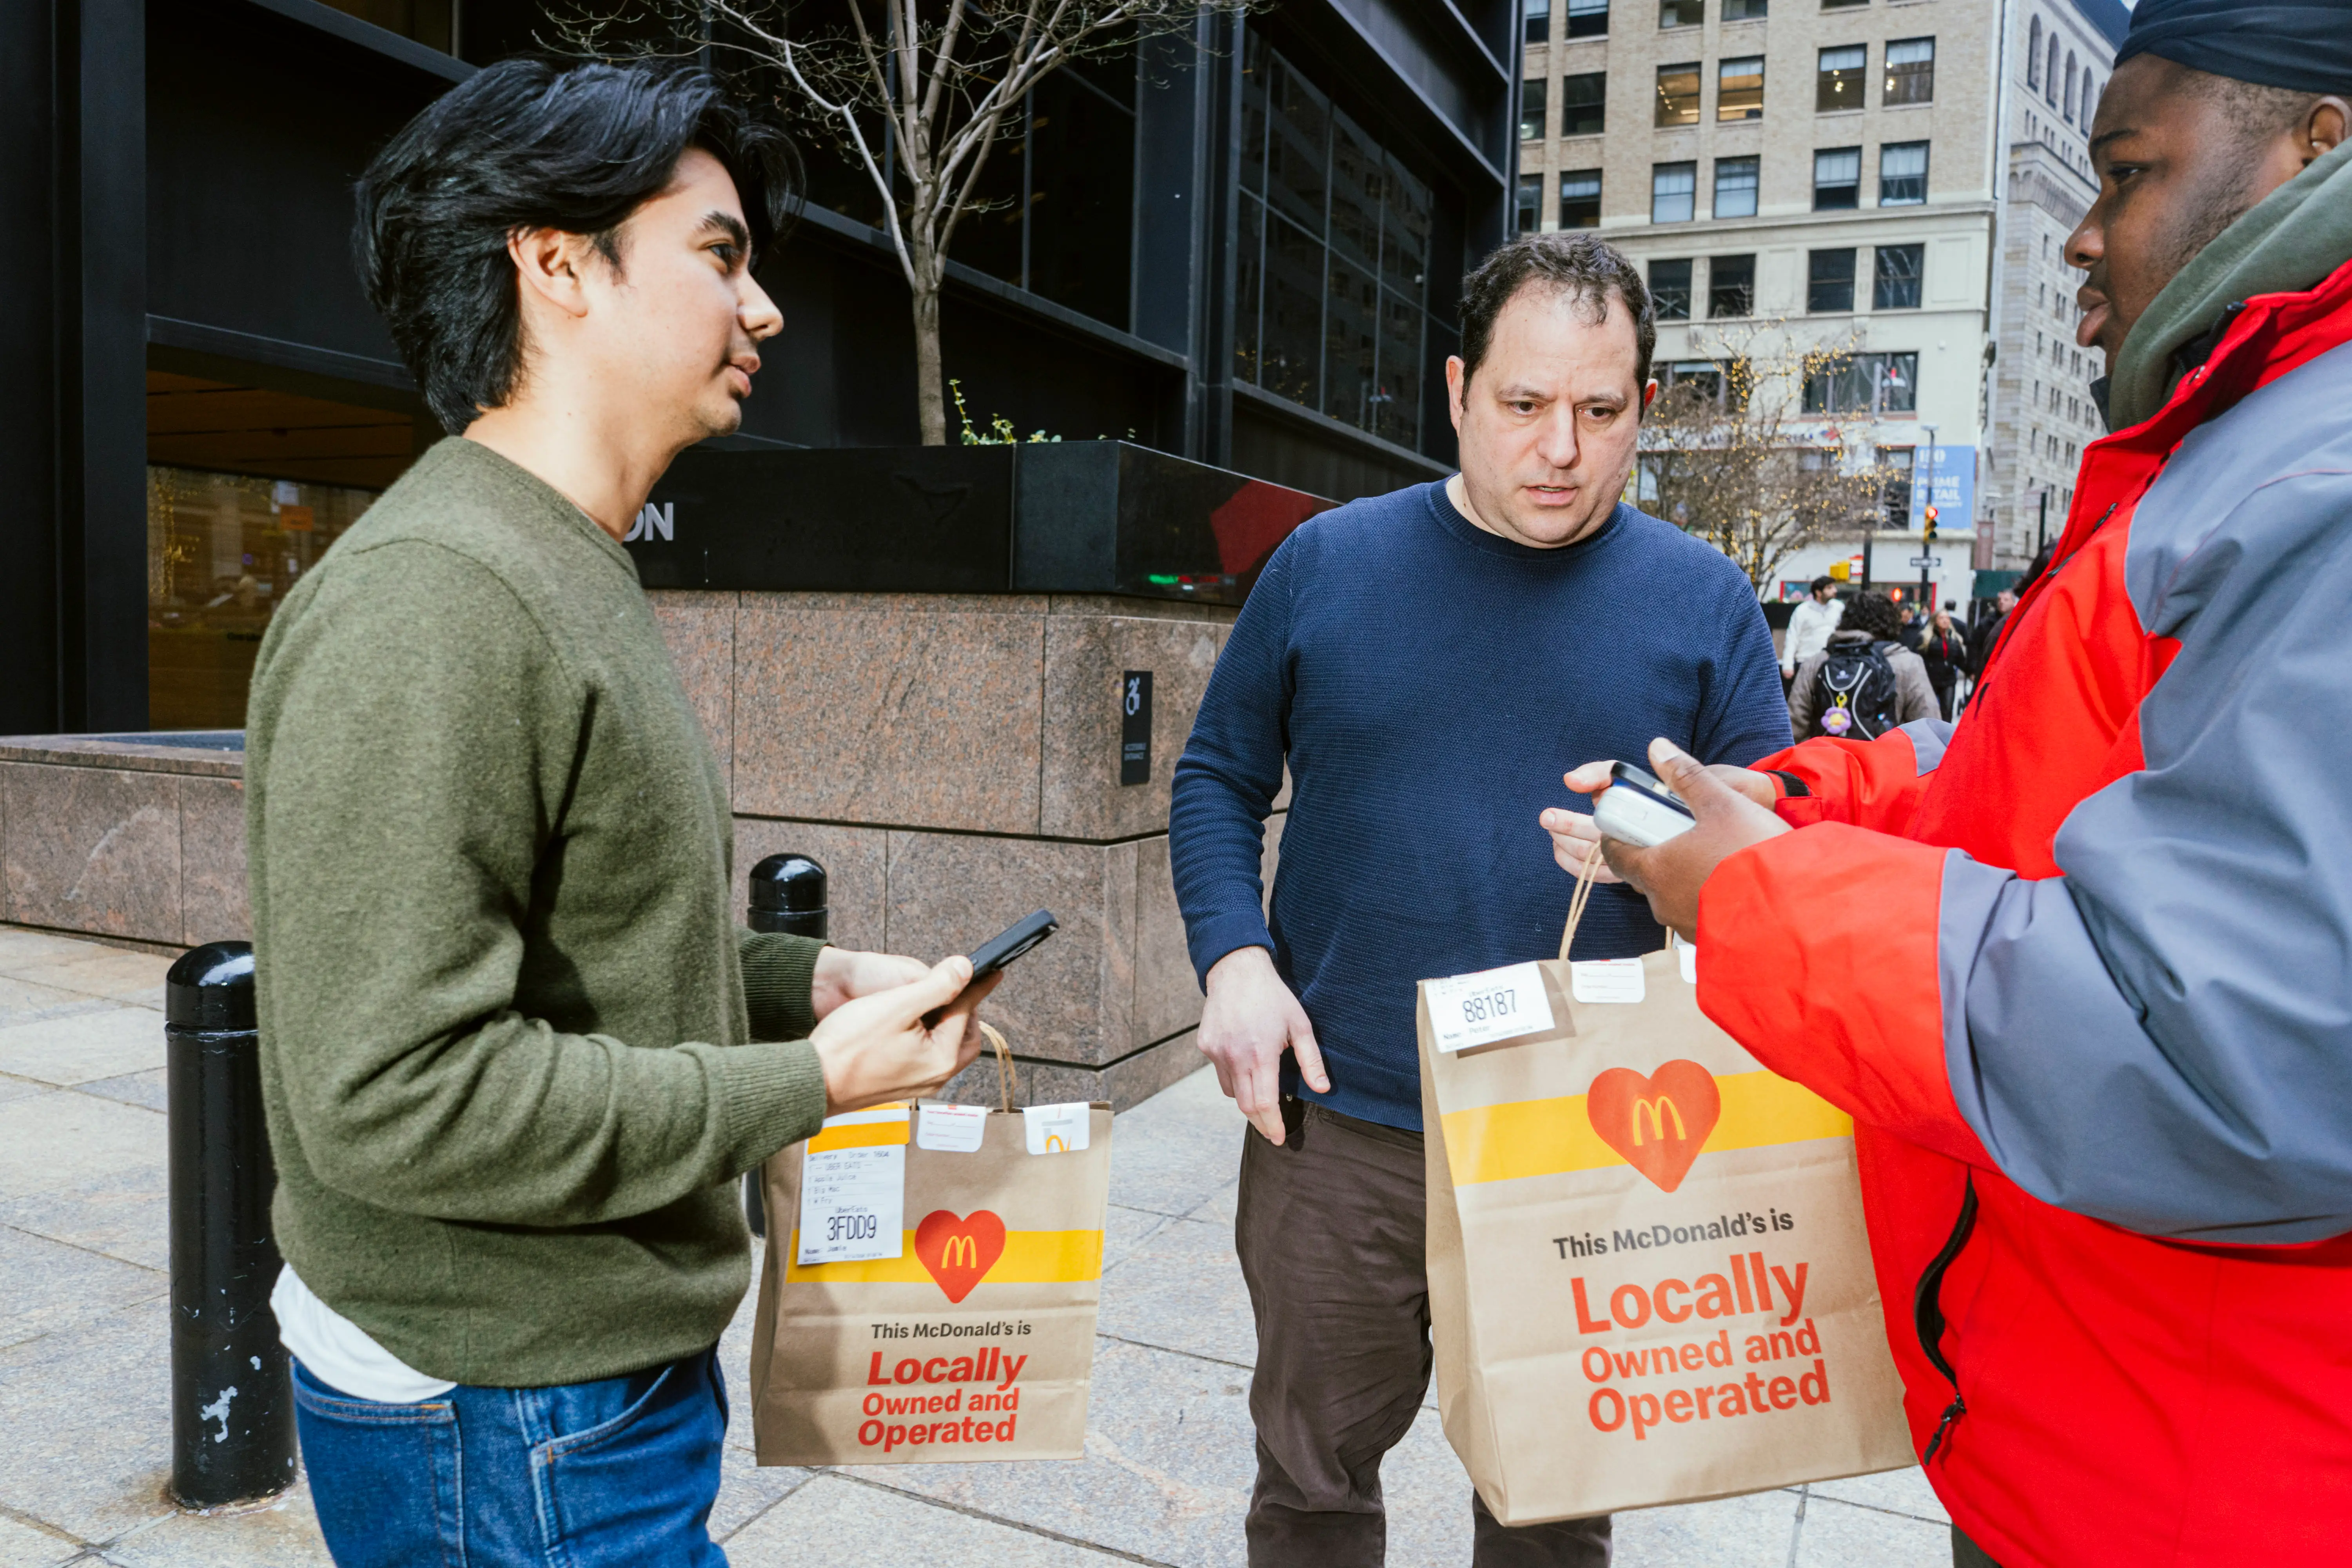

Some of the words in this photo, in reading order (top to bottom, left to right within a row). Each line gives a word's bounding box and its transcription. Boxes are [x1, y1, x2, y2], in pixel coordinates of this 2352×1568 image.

[1916, 488, 1960, 500] RTAIL
[1917, 475, 1960, 488] PIME
[1463, 989, 1517, 1023] 88187
[827, 1215, 877, 1241] 3FDD9
[1553, 1233, 1607, 1259] This
[1770, 1208, 1794, 1231] is
[1571, 1252, 1809, 1334] Locally
[871, 1323, 909, 1339] This
[1017, 1321, 1031, 1335] is
[1582, 1330, 1733, 1383] Owned
[1745, 1318, 1822, 1363] and
[867, 1347, 1028, 1392] Locally
[862, 1388, 962, 1417] Owned
[967, 1388, 1020, 1412] and
[1588, 1359, 1831, 1440] Operated
[858, 1414, 1017, 1453] Operated
